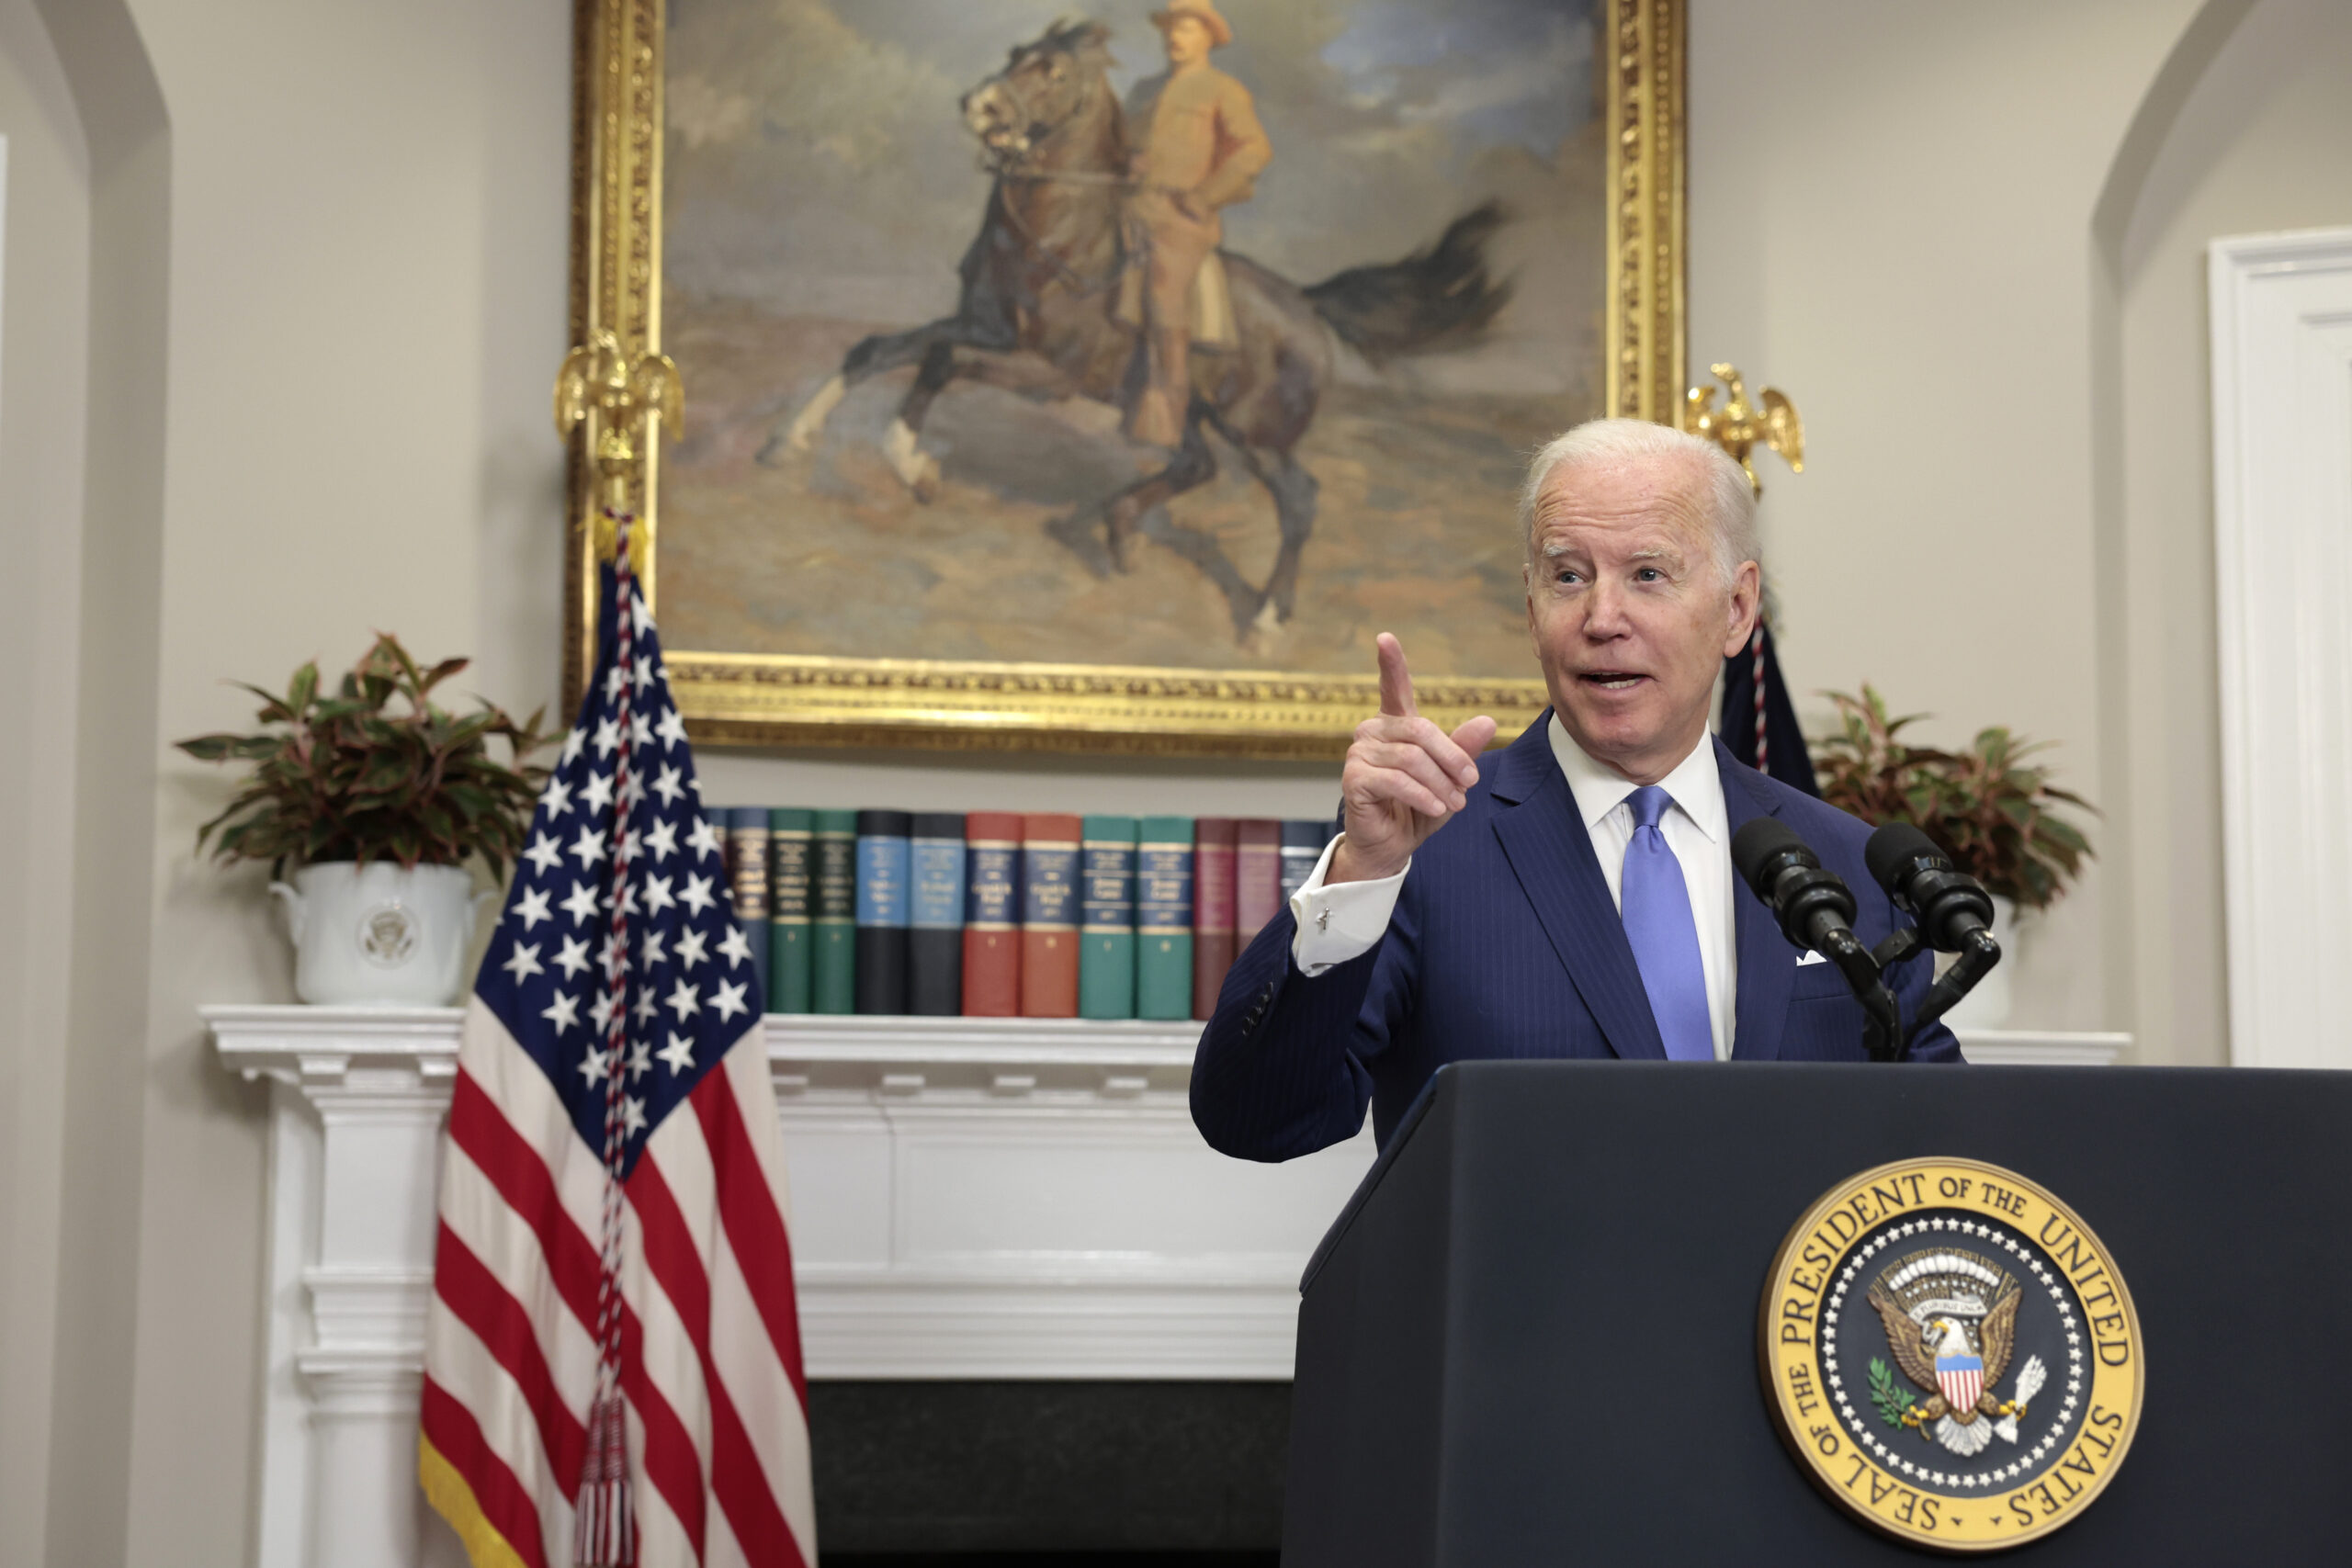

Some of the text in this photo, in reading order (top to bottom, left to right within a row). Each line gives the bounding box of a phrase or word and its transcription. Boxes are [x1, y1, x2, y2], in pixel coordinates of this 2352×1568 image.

[1781, 1172, 2131, 1531] SEAL OF THE PRESIDENT OF THE UNITED STATES
